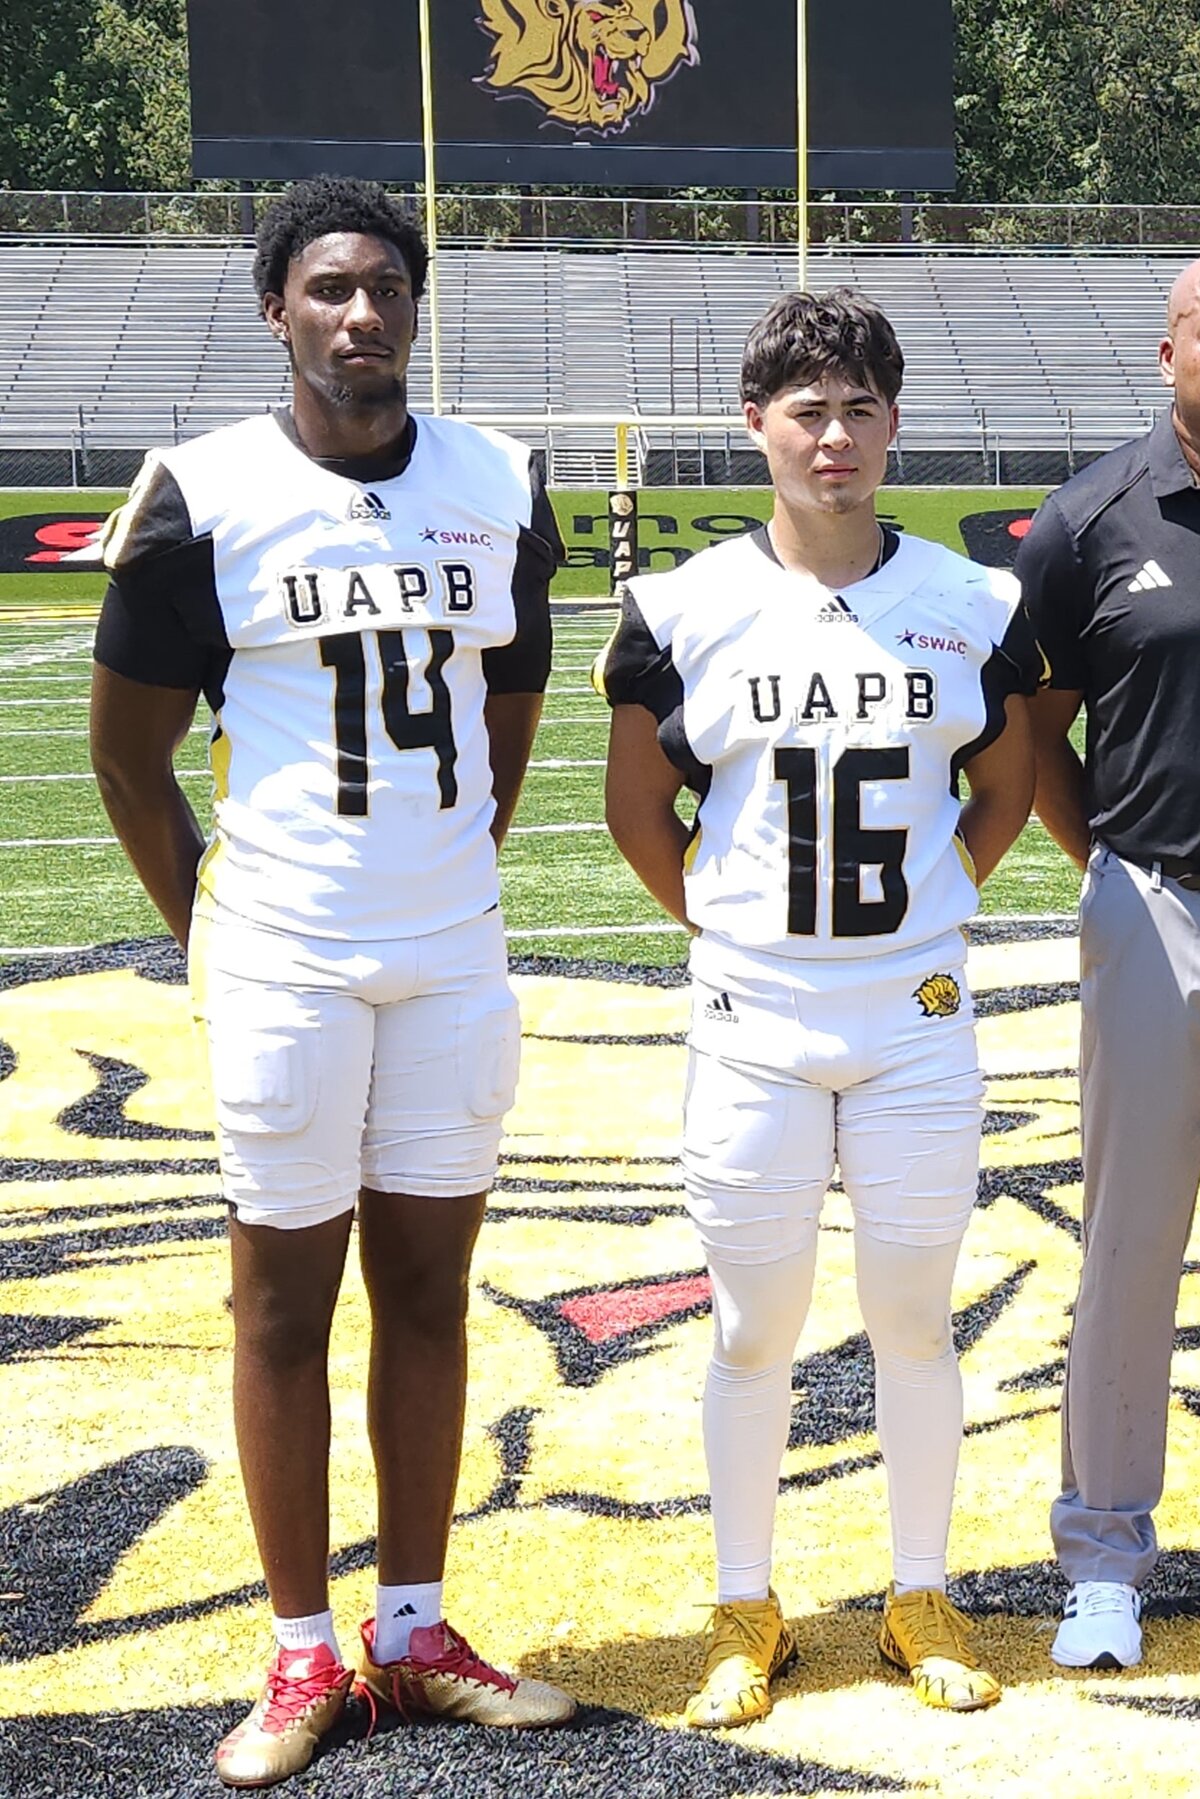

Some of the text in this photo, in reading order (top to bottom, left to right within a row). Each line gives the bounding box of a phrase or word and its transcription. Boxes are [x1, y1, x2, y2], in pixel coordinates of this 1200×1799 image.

[439, 531, 492, 547] SWAC
[282, 561, 476, 625] UAPB
[916, 634, 968, 655] SWAC
[317, 628, 459, 818] 14
[747, 670, 936, 724] UAPB
[772, 745, 911, 938] 16
